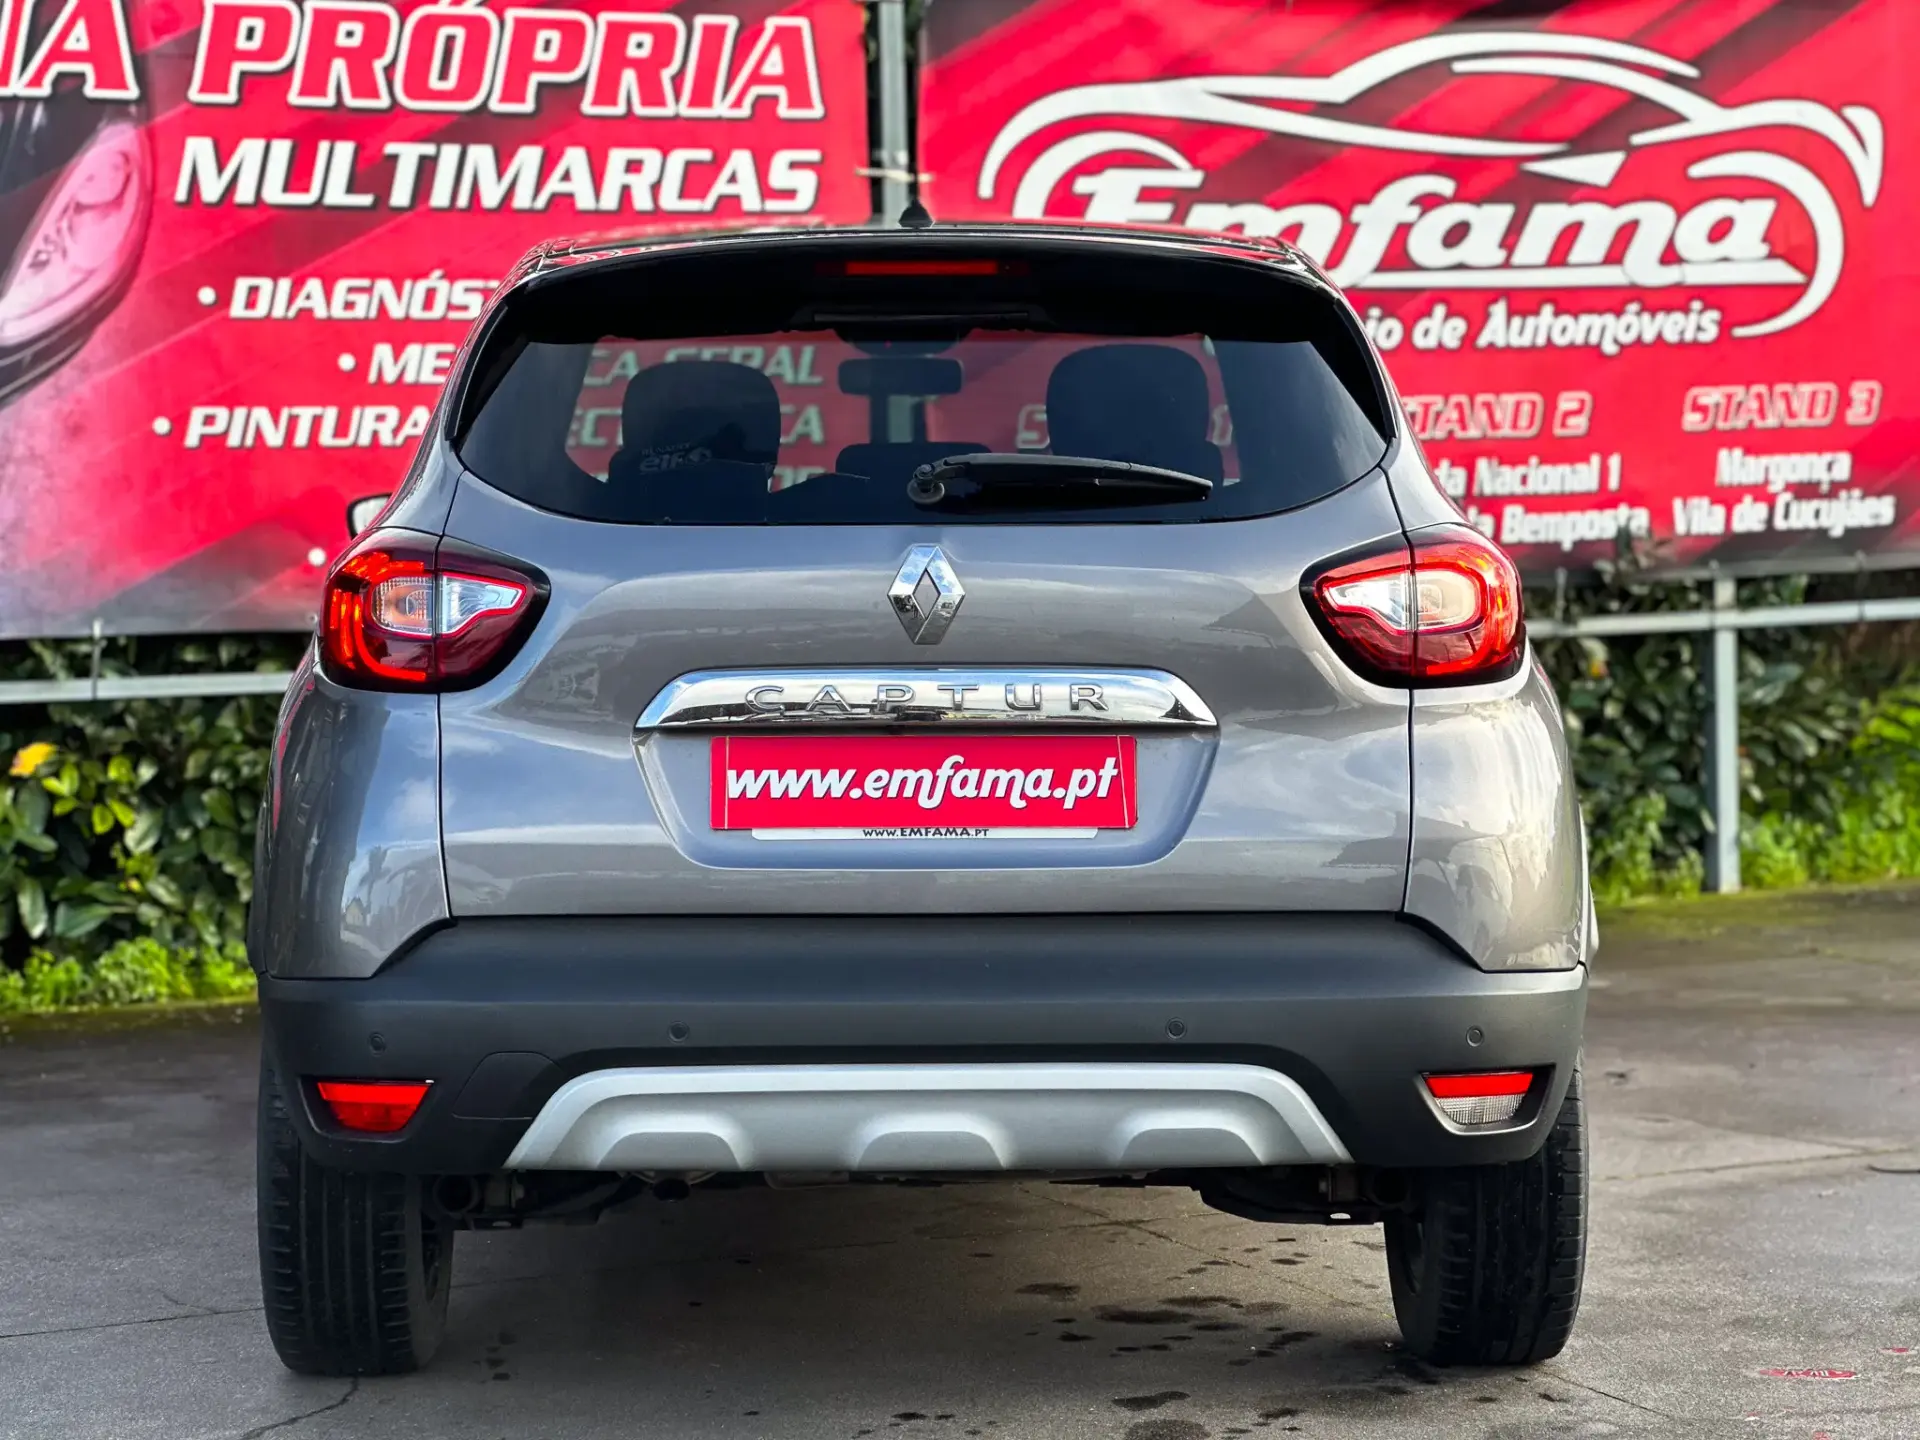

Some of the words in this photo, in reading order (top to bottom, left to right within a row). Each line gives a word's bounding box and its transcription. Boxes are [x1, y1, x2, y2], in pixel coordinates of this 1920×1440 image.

[174, 137, 822, 213] MULTIMARCAS
[1411, 303, 1468, 349] de
[1475, 298, 1722, 355] Automóveis
[1400, 393, 1544, 441] TAND
[1553, 390, 1592, 438] 2
[1681, 383, 1839, 432] STAND
[1845, 381, 1883, 426] 3
[1473, 453, 1602, 497] Nacional
[1607, 452, 1622, 491] 1
[1715, 447, 1853, 494] Margonça
[1500, 502, 1650, 551] Bemposta
[1672, 496, 1727, 537] Vila
[1731, 494, 1768, 533] de
[1772, 487, 1897, 538] Cucujães
[745, 683, 1110, 713] CAPTUR
[726, 755, 1119, 809] www.emfama.pt
